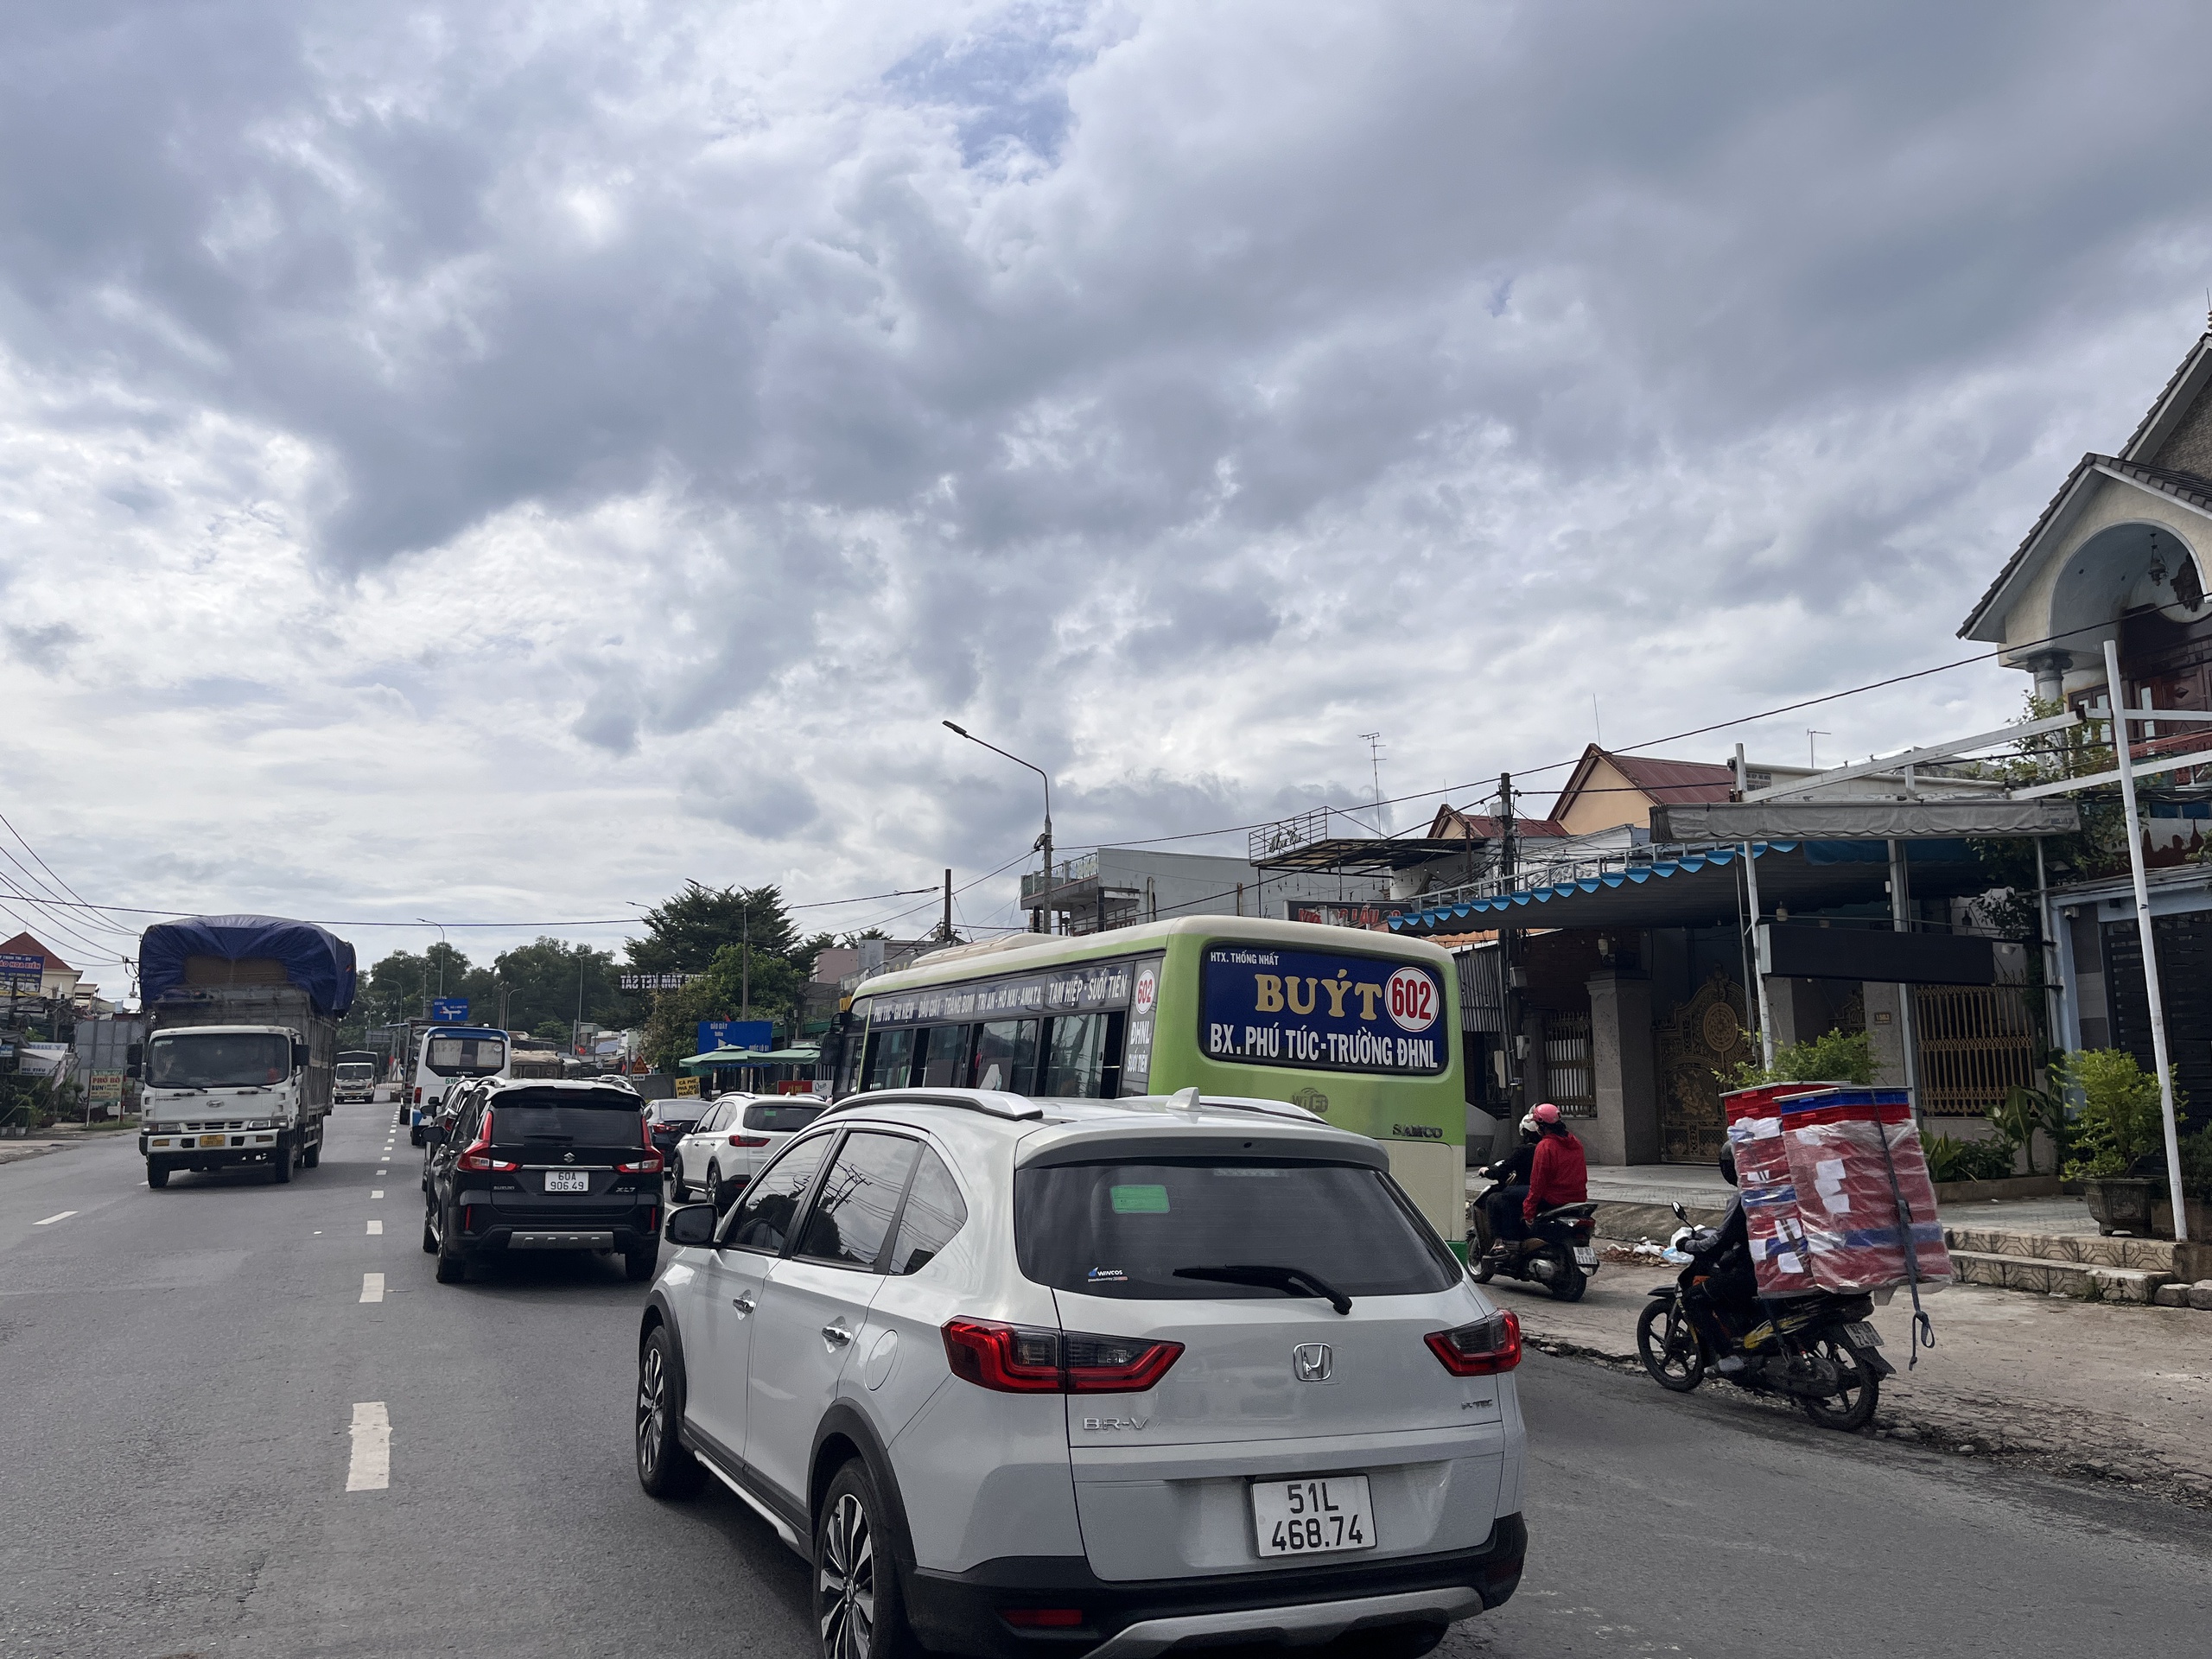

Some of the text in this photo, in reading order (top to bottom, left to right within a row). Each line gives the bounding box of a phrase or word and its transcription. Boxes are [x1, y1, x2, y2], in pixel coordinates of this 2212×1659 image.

[1211, 950, 1279, 966] HTX. THỐNG NHẤT
[1048, 981, 1065, 1004] TAM
[1064, 976, 1084, 1007] HIỆP
[1087, 968, 1108, 1001] SUỐI
[1108, 969, 1128, 998] TIÊN
[1137, 978, 1153, 1005] 602
[1255, 969, 1382, 1020] BUÝT
[1391, 976, 1432, 1020] 602
[1130, 1020, 1150, 1045] ĐHNL
[1210, 1023, 1242, 1055] BX.
[1245, 1022, 1280, 1058] PHÚ
[1396, 1038, 1438, 1068] ĐHNL
[550, 1181, 584, 1191] 906.49
[558, 1172, 576, 1181] 60A
[1083, 1417, 1148, 1431] BR-V
[1287, 1482, 1339, 1515] 51L
[1271, 1515, 1363, 1552] 468.74
